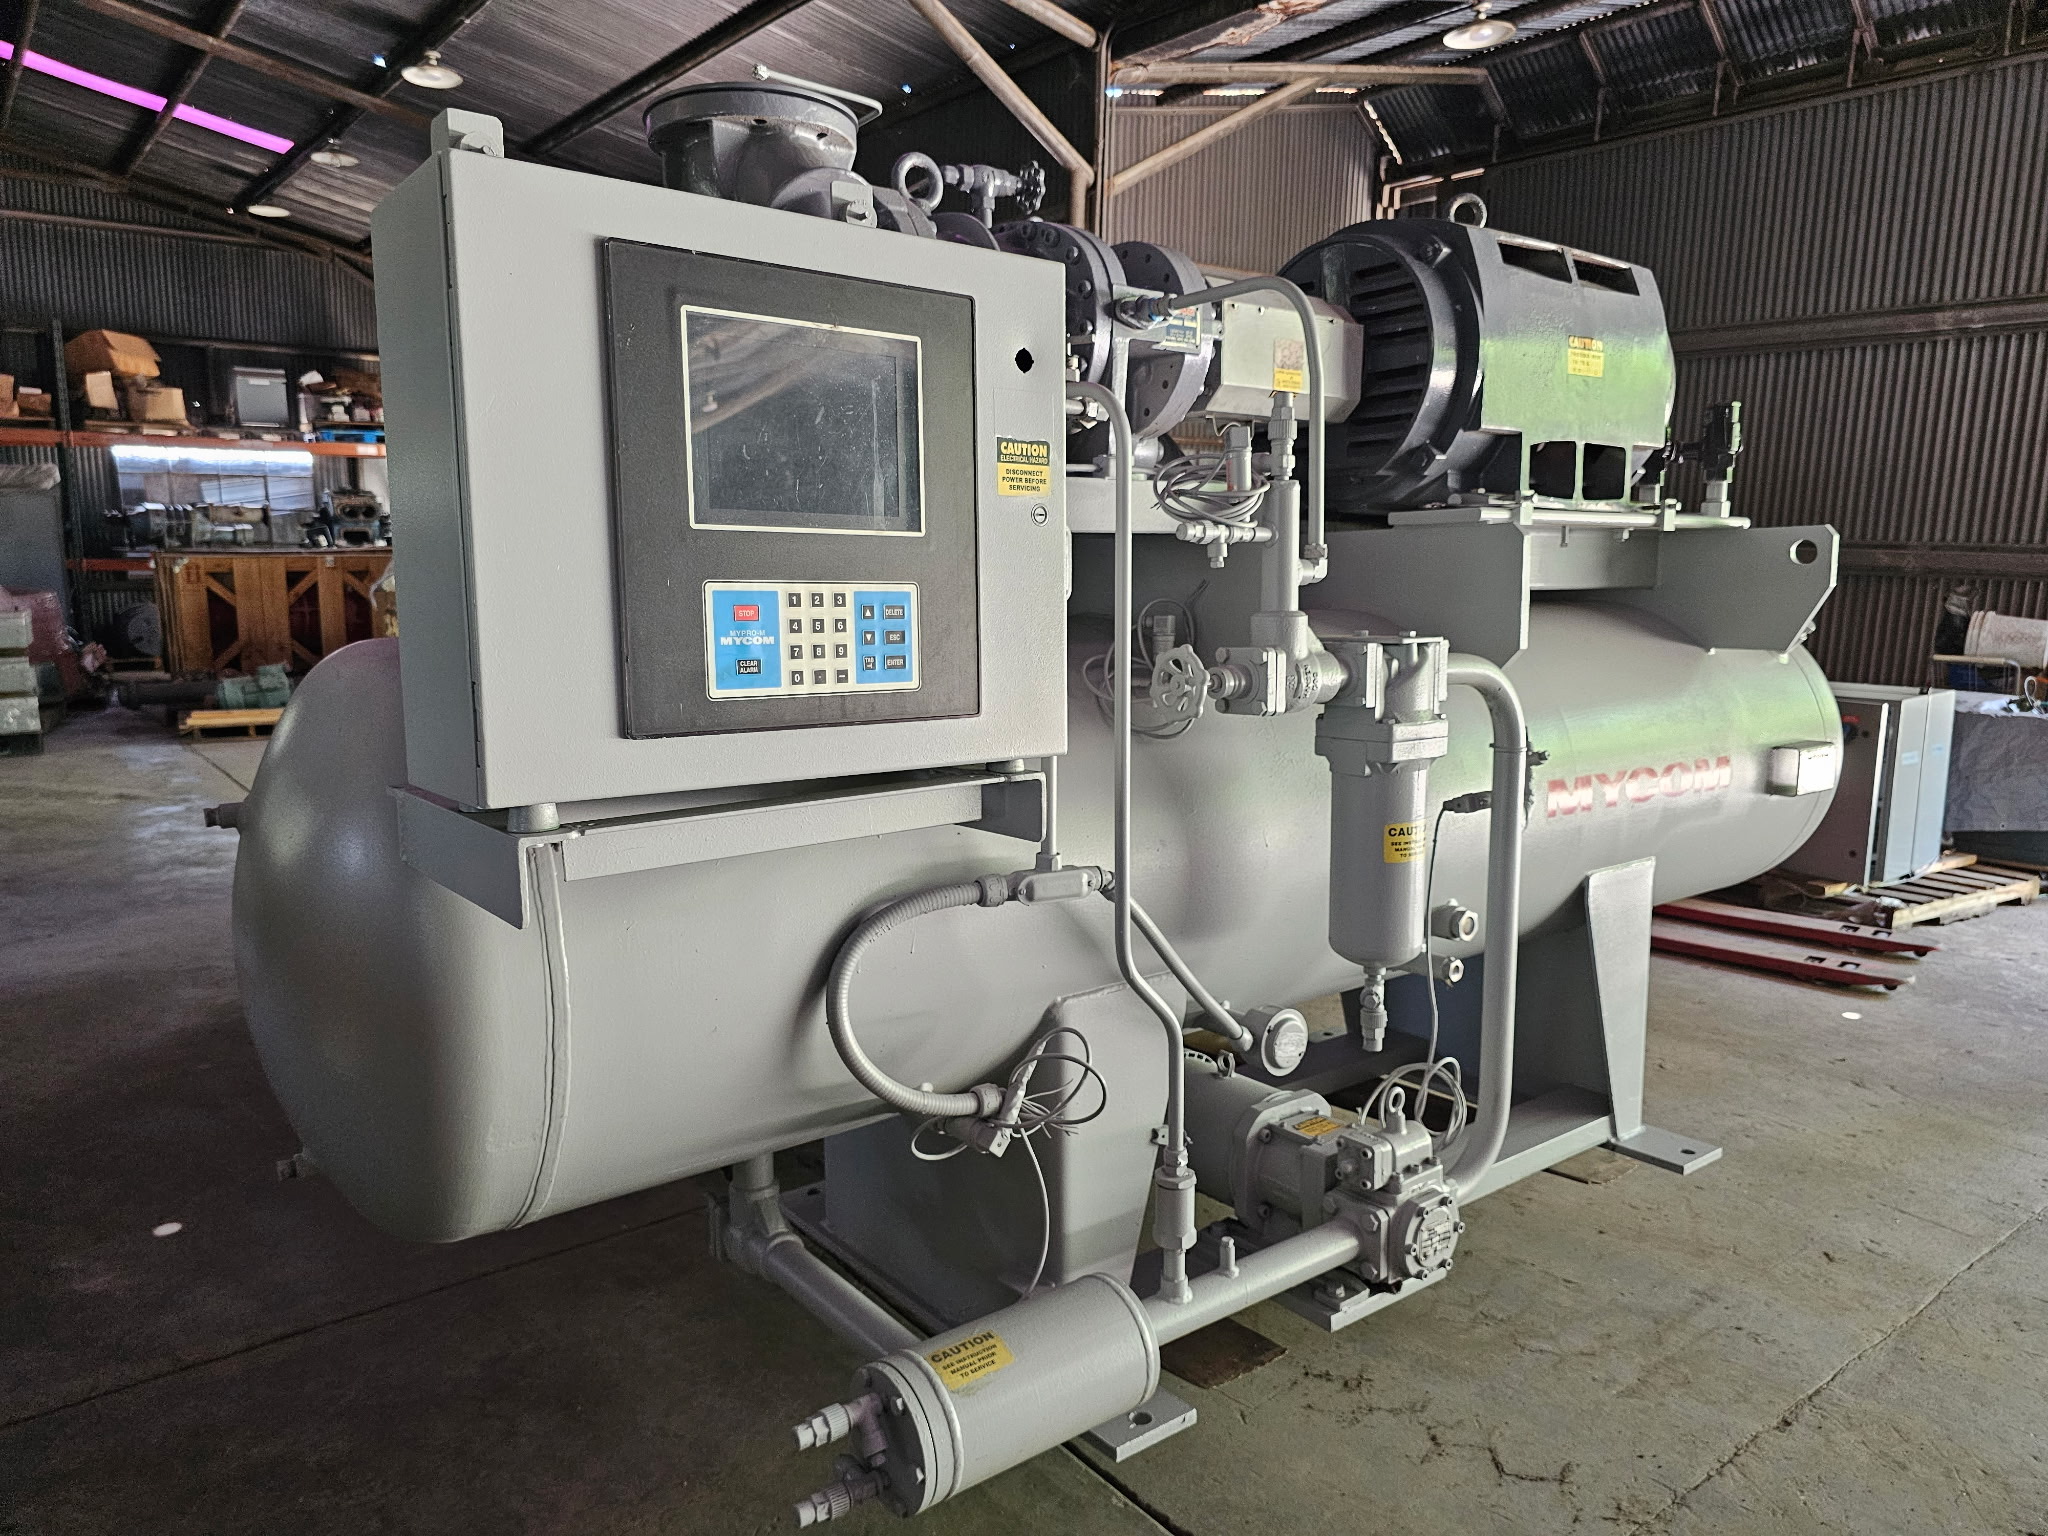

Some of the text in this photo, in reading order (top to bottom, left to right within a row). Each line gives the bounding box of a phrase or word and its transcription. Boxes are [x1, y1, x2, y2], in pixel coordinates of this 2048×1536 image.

[1000, 442, 1048, 458] CAUTION
[1000, 455, 1029, 463] ELECTRICAL
[1006, 468, 1043, 476] DISCONNECT
[792, 596, 843, 604] 1 2 3
[792, 622, 843, 630] 4 5 6
[720, 636, 775, 645] MYCOM
[793, 647, 844, 656] 7 8 9
[794, 674, 800, 682] 0
[1547, 756, 1731, 818] MYCOM
[930, 1332, 994, 1363] CAUTION
[942, 1344, 997, 1370] SEE INSTRUCTION
[951, 1352, 997, 1375] MANUAL PRIOR
[970, 1360, 996, 1374] SERVICE
